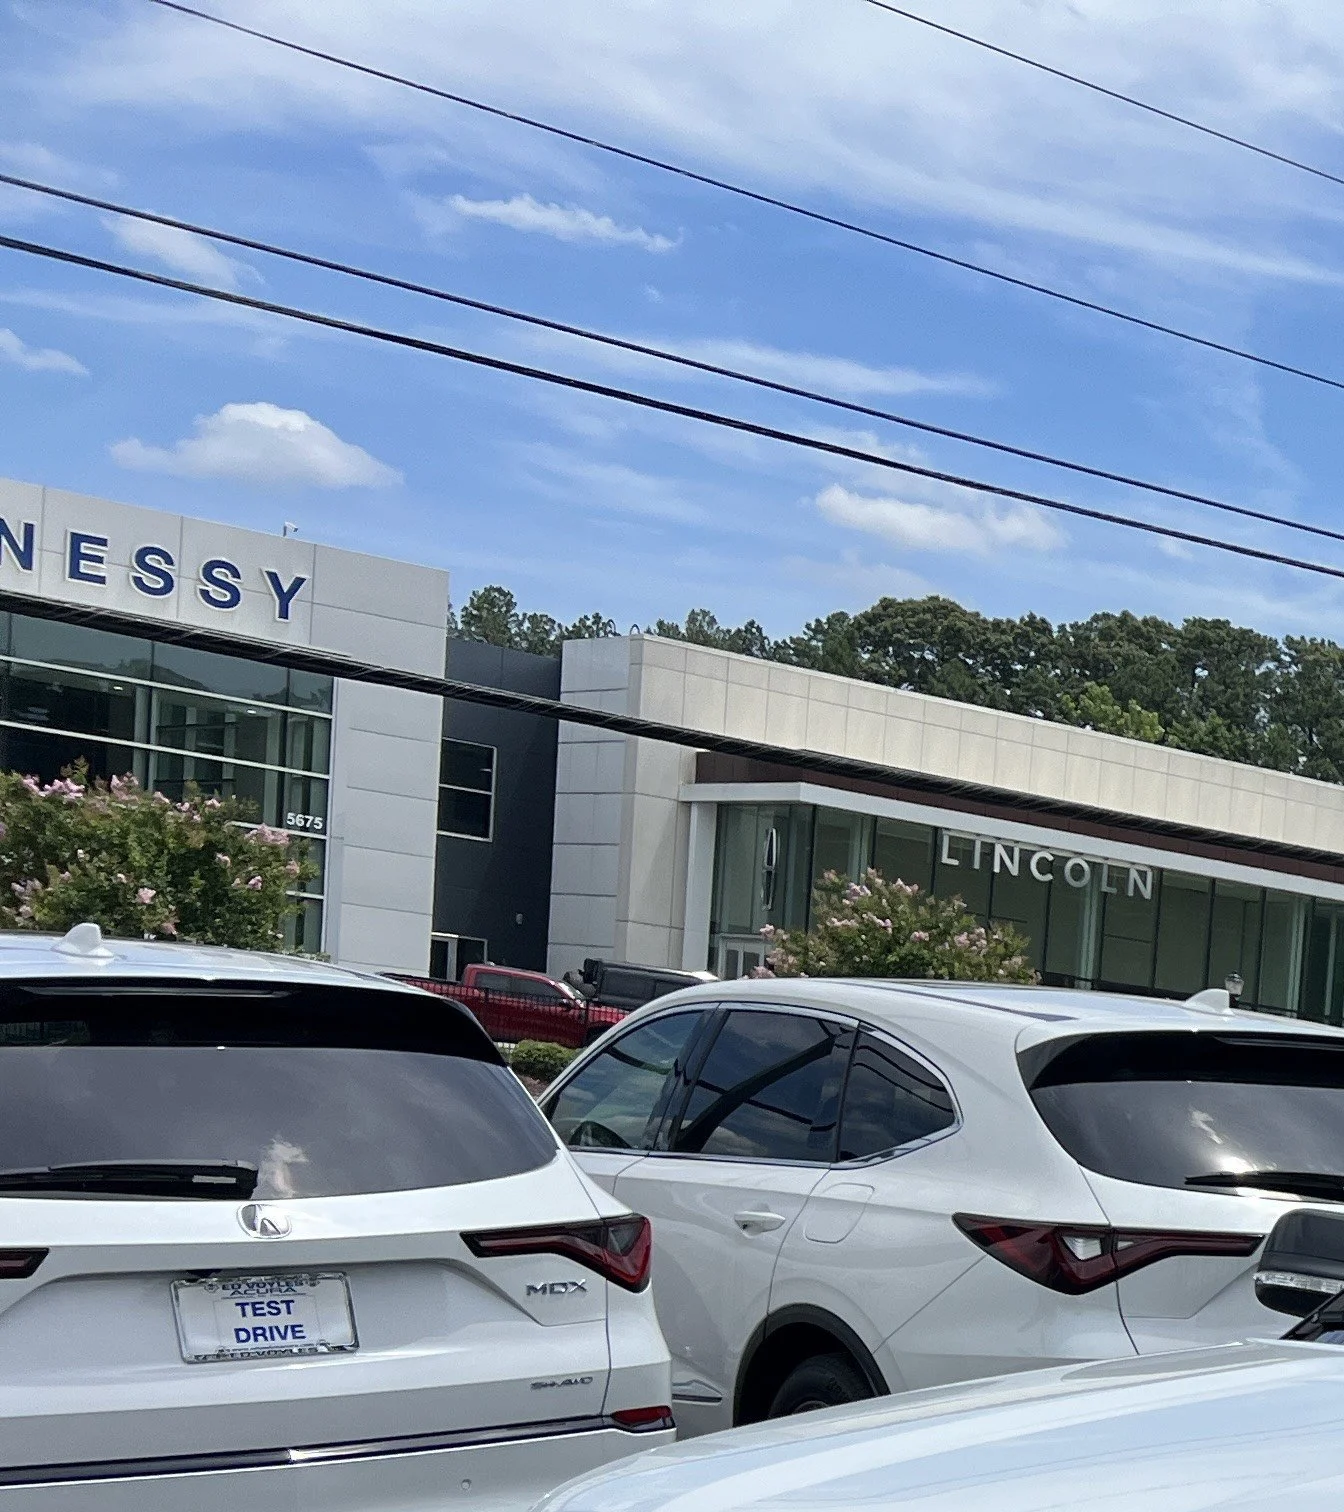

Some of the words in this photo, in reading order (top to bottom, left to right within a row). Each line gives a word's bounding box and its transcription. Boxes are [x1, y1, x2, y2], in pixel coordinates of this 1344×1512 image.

[0, 514, 307, 621] NESSY
[286, 811, 323, 830] 5675
[940, 833, 1153, 900] LINCOLN
[221, 1283, 242, 1291] ED
[229, 1287, 298, 1297] ACURA
[526, 1278, 587, 1296] MDX
[234, 1299, 295, 1318] TEST
[233, 1323, 306, 1344] DRIVE
